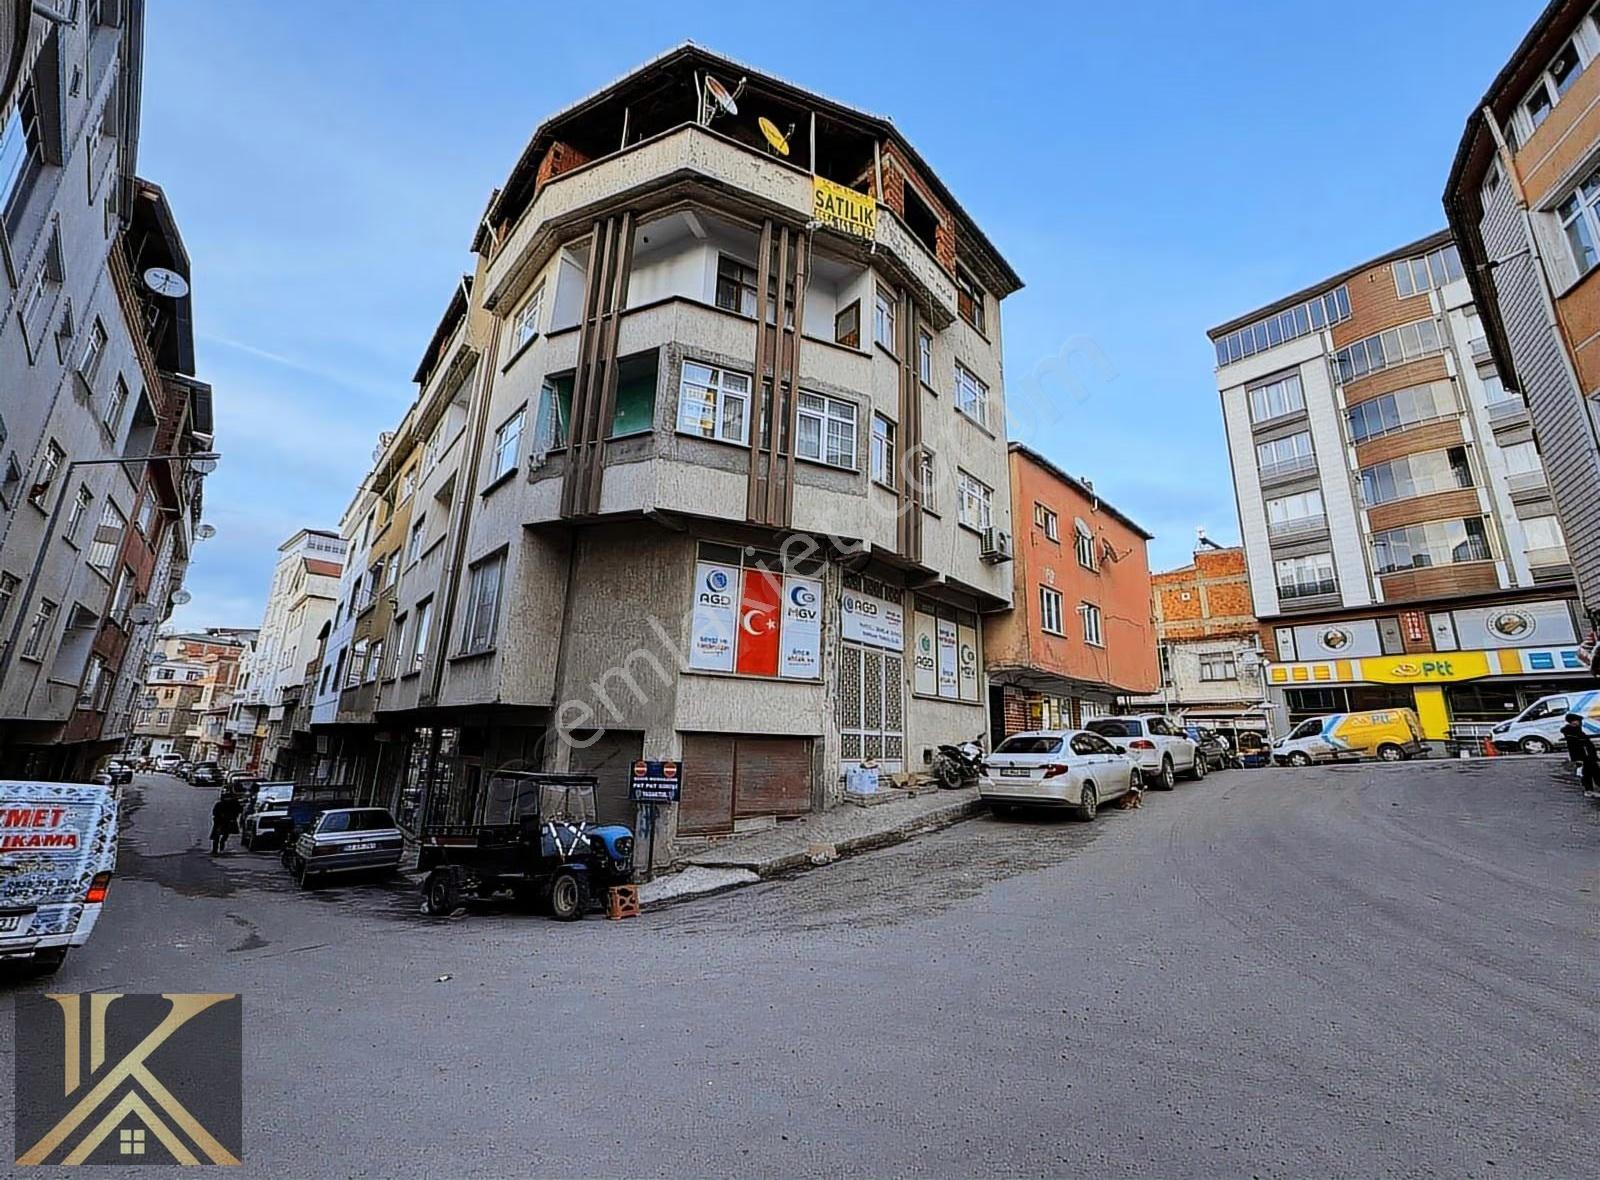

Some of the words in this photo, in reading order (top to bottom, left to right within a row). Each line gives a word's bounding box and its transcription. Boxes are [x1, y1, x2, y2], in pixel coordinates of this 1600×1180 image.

[815, 190, 874, 227] SATILIK
[700, 592, 731, 606] AGD
[788, 607, 816, 619] MGV
[855, 600, 877, 615] AGD
[915, 655, 934, 668] AGD
[1423, 661, 1454, 677] Ptt
[0, 809, 64, 827] MET
